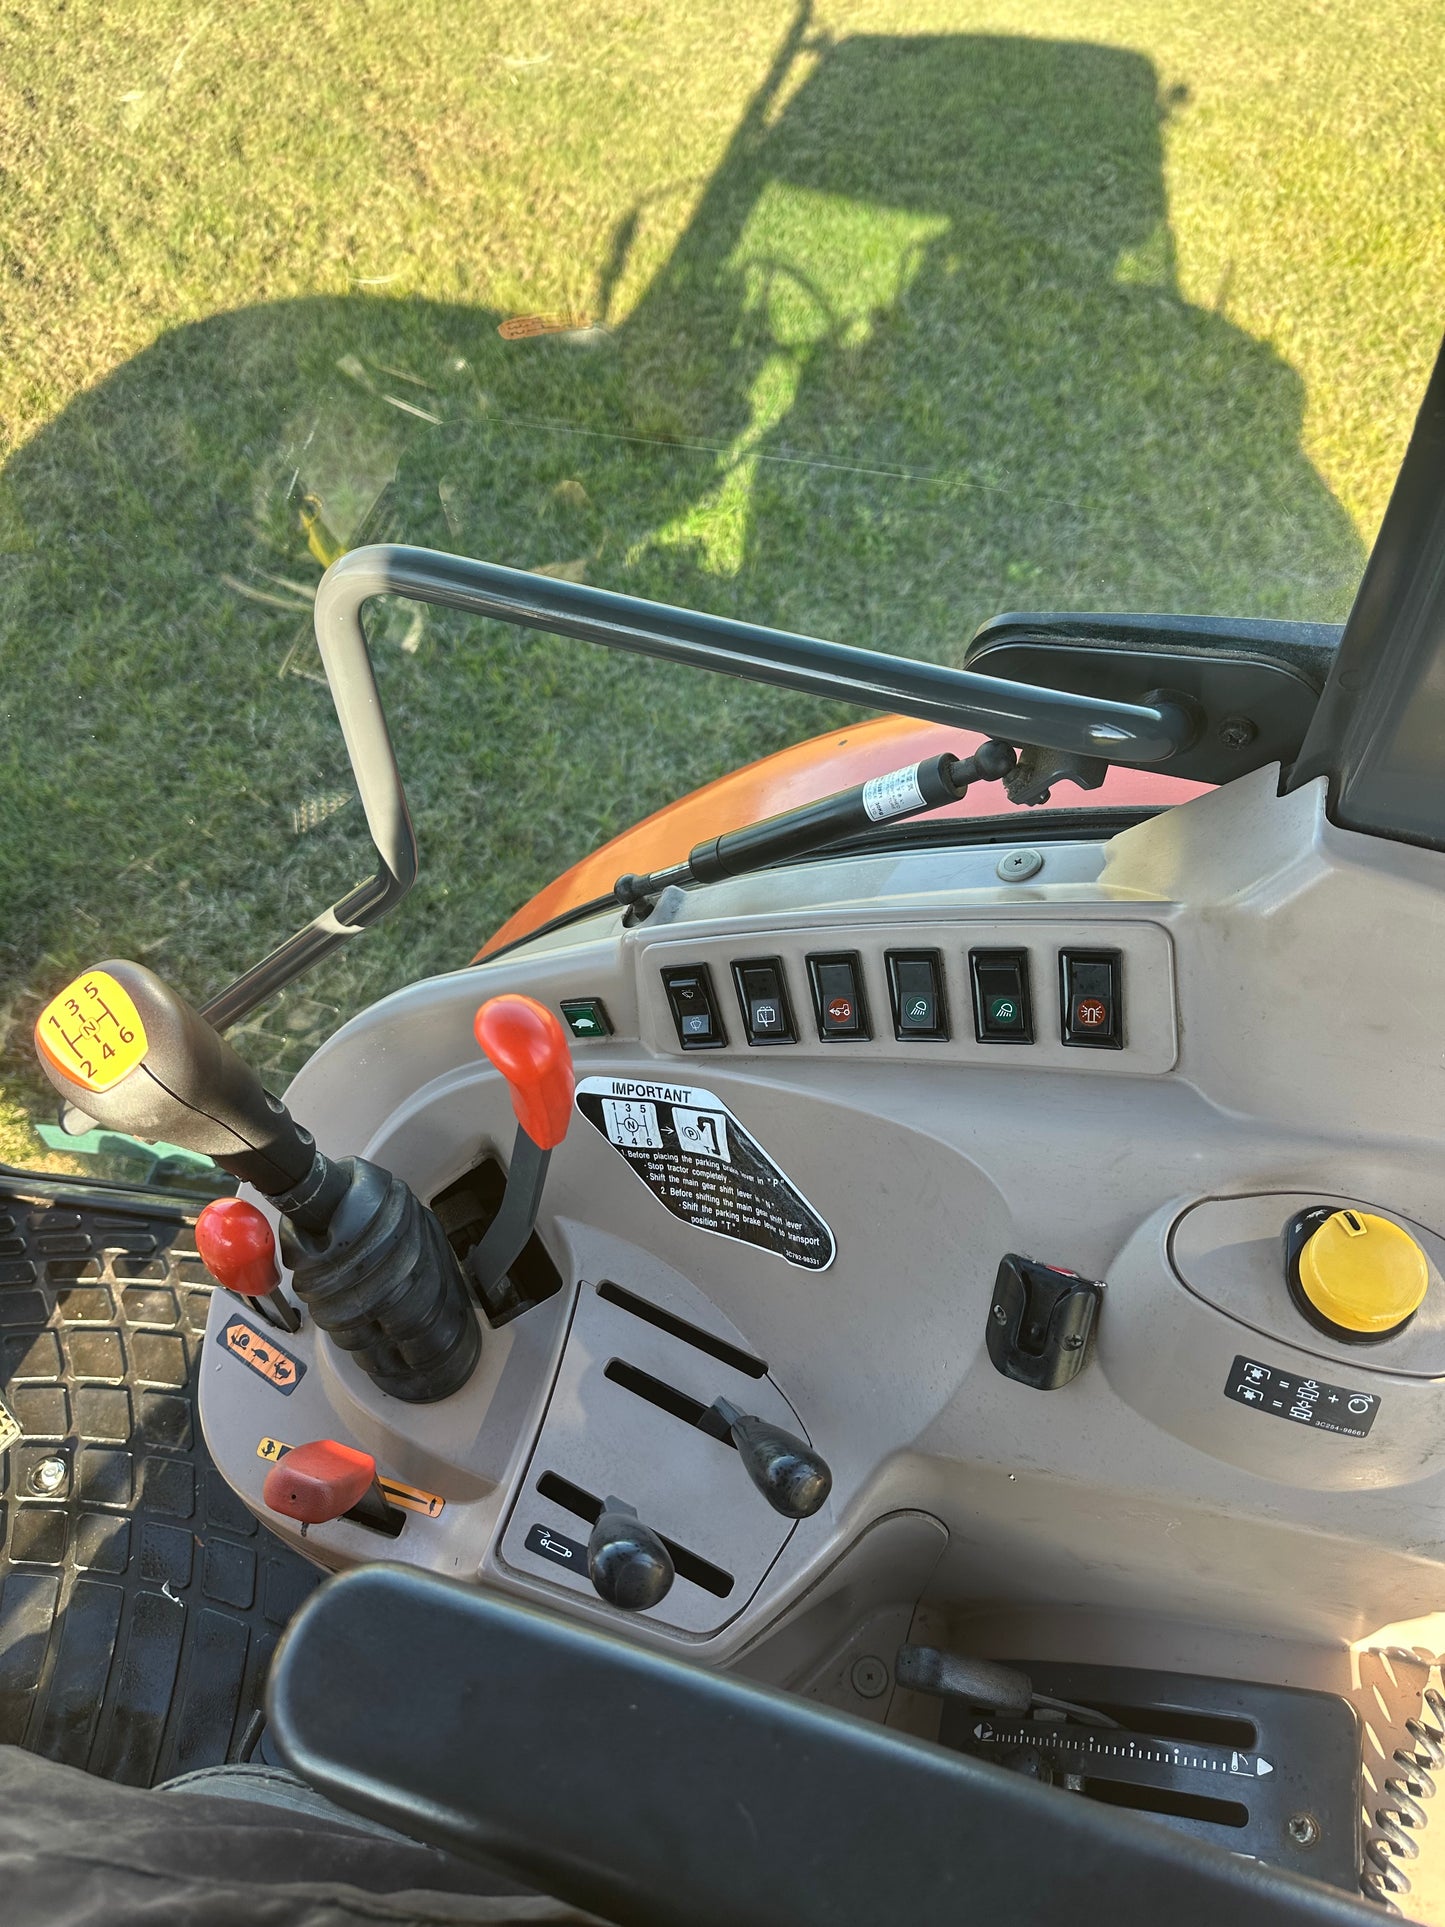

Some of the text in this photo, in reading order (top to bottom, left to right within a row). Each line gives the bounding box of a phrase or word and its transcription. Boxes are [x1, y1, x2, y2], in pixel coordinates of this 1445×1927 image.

[48, 981, 99, 1029] 1 3 5
[83, 1020, 97, 1036] N
[80, 1026, 135, 1079] 2 4 6
[612, 1081, 692, 1104] IMPORTANT
[611, 1102, 646, 1113] 1 3 5
[627, 1121, 635, 1129] N
[687, 1130, 695, 1138] P
[618, 1136, 653, 1146] 2 4 6
[627, 1150, 650, 1160] Before
[653, 1152, 679, 1163] placing
[681, 1155, 692, 1164] the
[695, 1158, 720, 1170] parking
[757, 1176, 764, 1185] in
[667, 1164, 689, 1174] tractor
[669, 1175, 680, 1183] the
[682, 1178, 699, 1187] main
[702, 1181, 716, 1191] gear
[719, 1185, 734, 1195] shift
[736, 1188, 752, 1200] lever
[670, 1187, 693, 1198] Before
[695, 1192, 720, 1205] shifting
[722, 1198, 733, 1207] the
[736, 1203, 753, 1213] main
[756, 1207, 768, 1218] gear
[769, 1214, 783, 1224] shift
[785, 1218, 802, 1230] lever
[690, 1216, 718, 1227] position
[701, 1204, 712, 1214] the
[715, 1208, 740, 1222] parking
[742, 1214, 761, 1226] brake
[779, 1228, 785, 1237] to
[787, 1231, 820, 1246] transport
